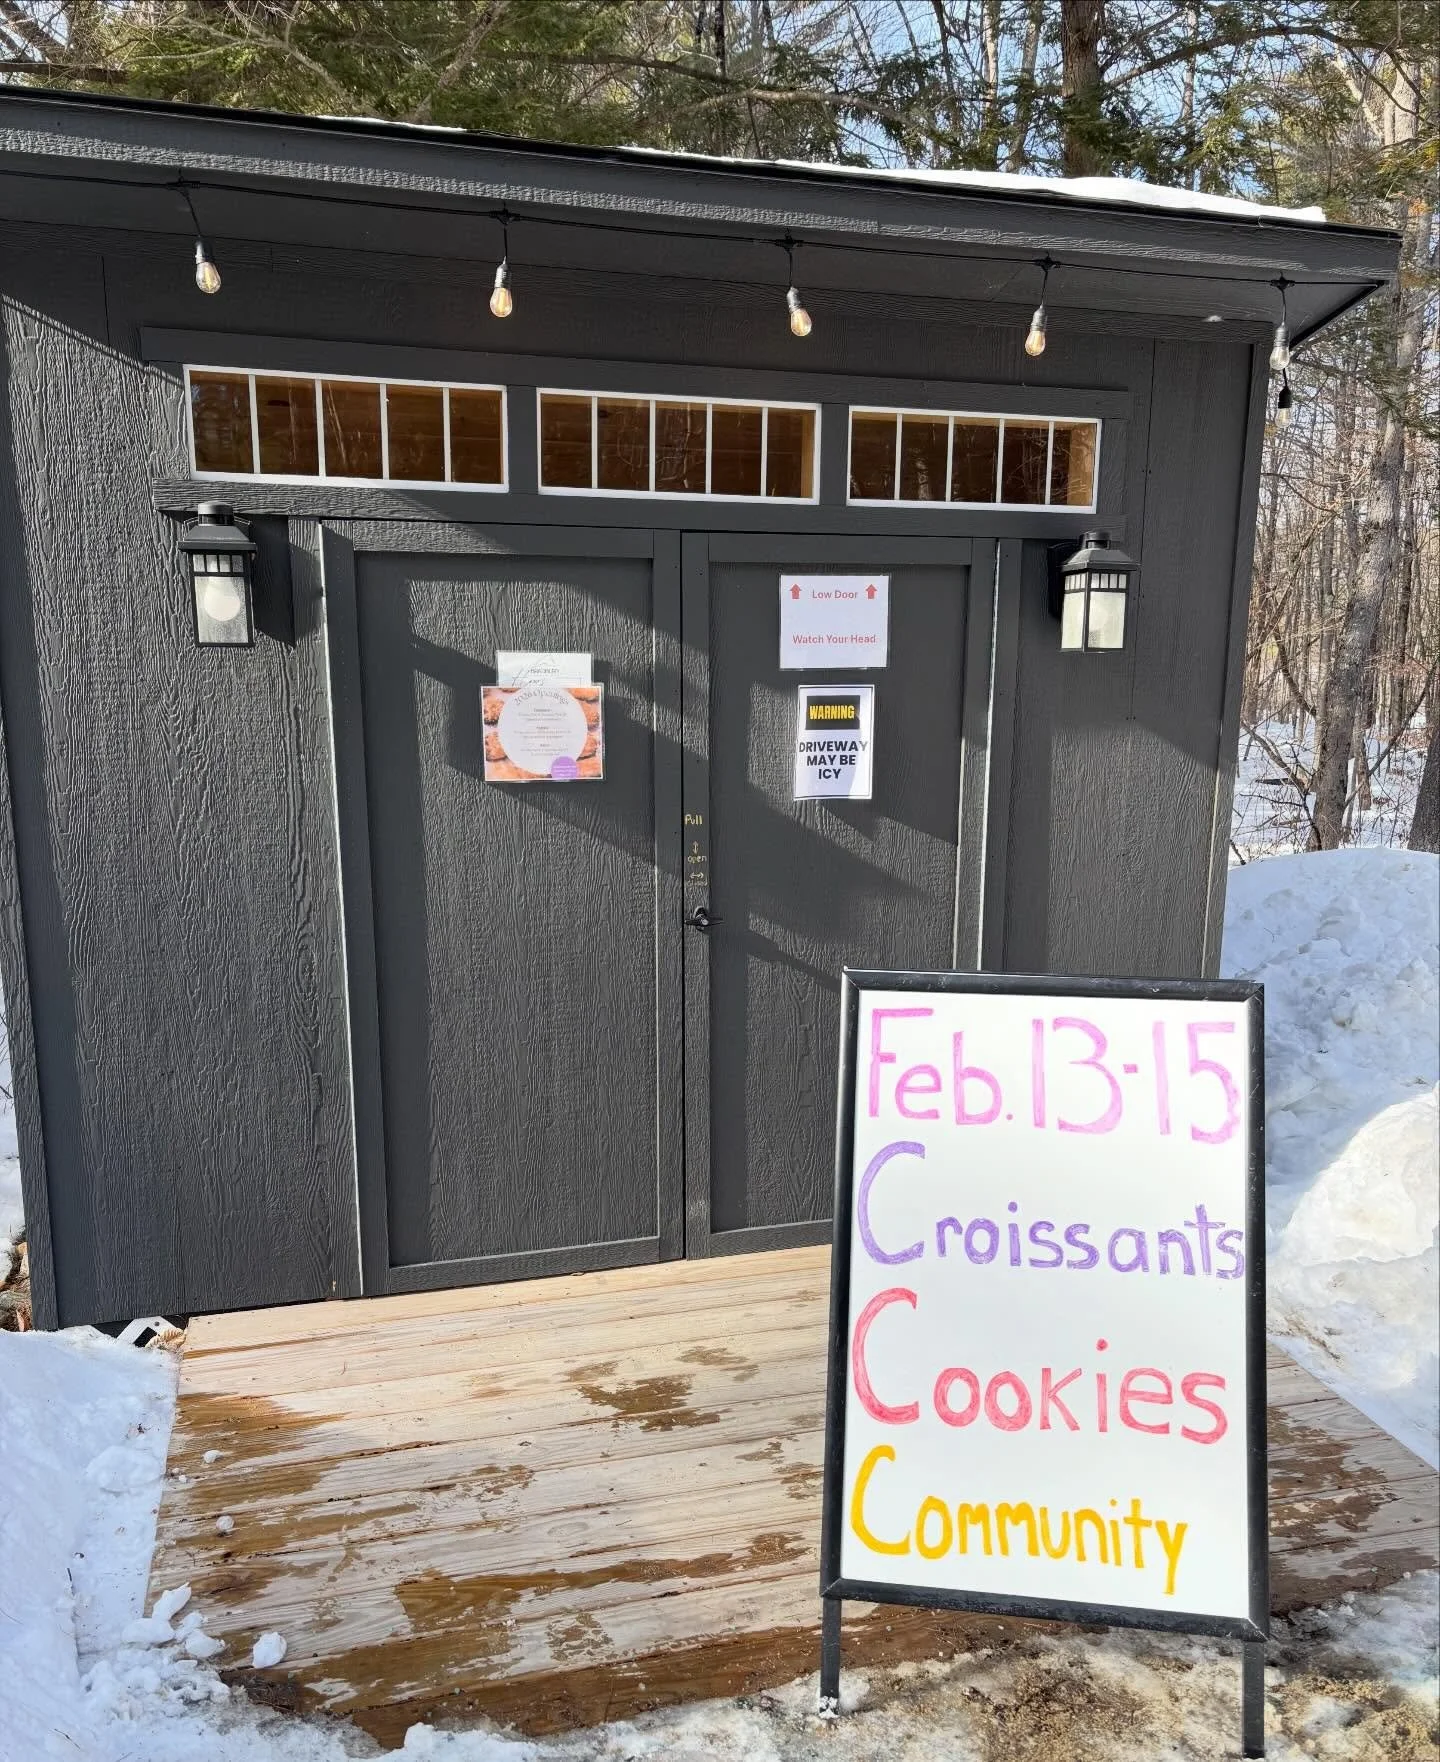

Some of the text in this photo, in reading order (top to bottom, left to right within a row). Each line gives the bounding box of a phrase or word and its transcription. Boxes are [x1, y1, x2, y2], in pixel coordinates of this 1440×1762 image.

[812, 589, 859, 599] Low Door
[792, 634, 876, 644] Watch Your Head
[809, 705, 855, 720] WARNING
[799, 740, 868, 752] DRIVEWAY
[806, 754, 857, 766] MAY BE
[818, 768, 842, 779] ICY
[684, 813, 703, 825] Pull
[868, 1007, 1242, 1142] Feb. 13-15
[857, 1140, 1246, 1279] Croissants
[851, 1287, 1229, 1445] Cookies
[850, 1444, 1189, 1595] Community
